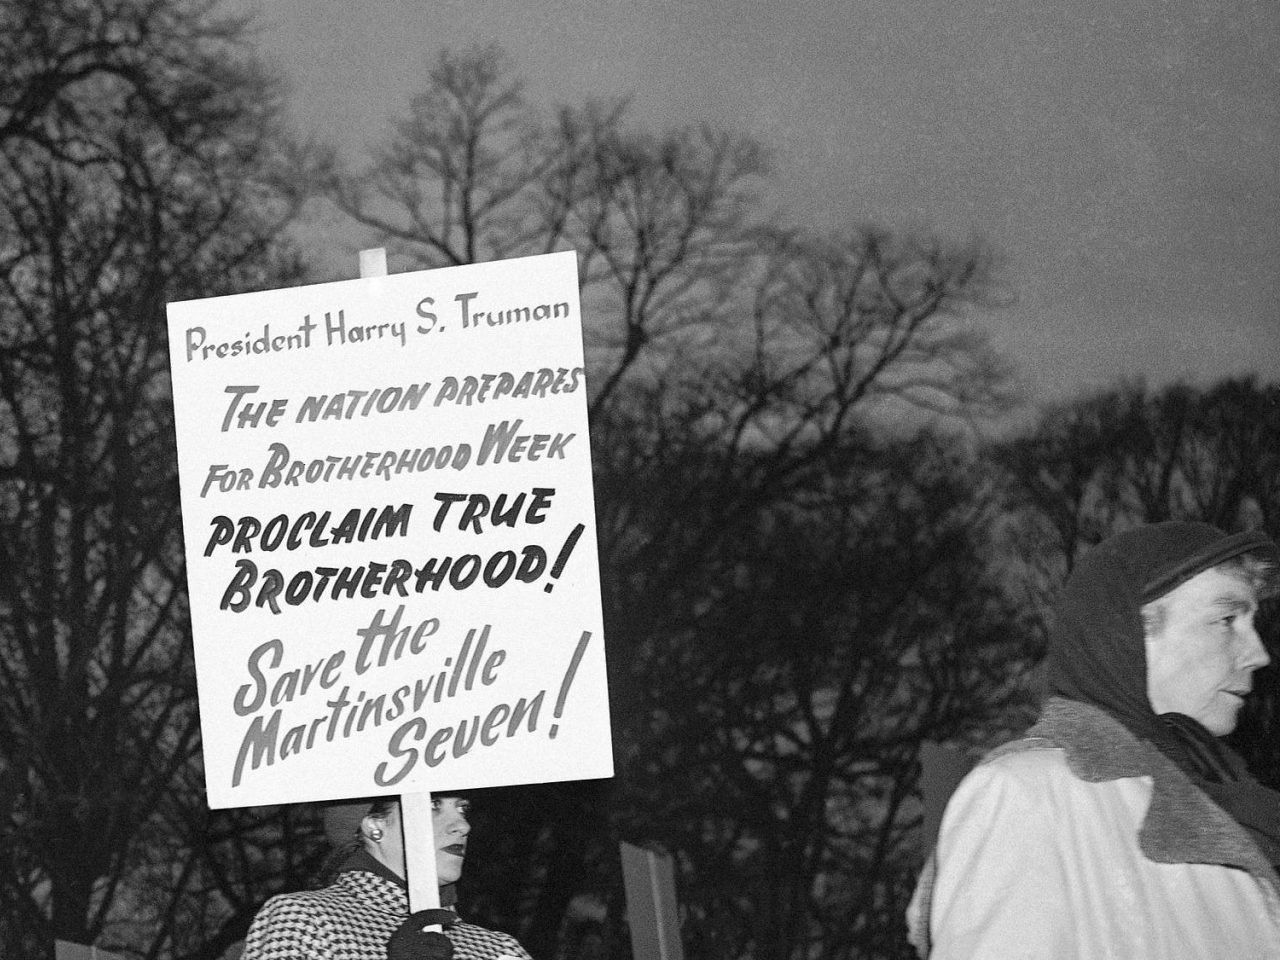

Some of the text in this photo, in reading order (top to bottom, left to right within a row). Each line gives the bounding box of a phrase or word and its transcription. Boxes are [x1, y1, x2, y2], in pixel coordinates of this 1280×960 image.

[186, 292, 569, 361] President Harry S. Truman
[221, 367, 584, 432] THE NATION PREPARES
[200, 419, 576, 498] FOR BROTHERHOOD WEEK
[203, 488, 555, 557] PROCLAIM TRUE
[220, 523, 585, 614] BROTHERHOOD!
[233, 605, 440, 716] Save the
[232, 624, 506, 787] Martinsville
[373, 630, 592, 787] Seven!
